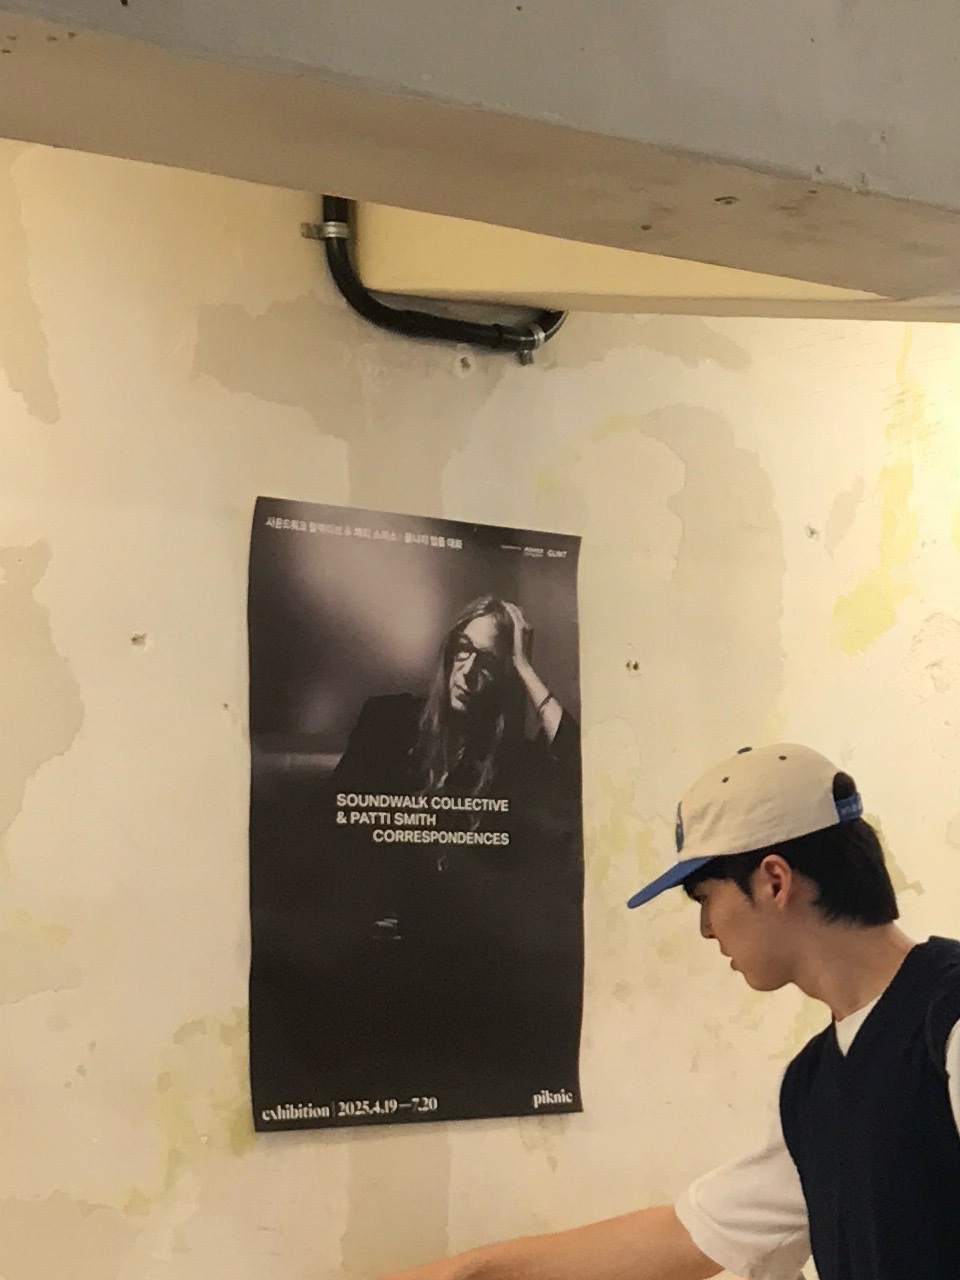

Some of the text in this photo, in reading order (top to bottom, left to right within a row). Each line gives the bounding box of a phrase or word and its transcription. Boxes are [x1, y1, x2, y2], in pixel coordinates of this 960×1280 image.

[336, 793, 509, 812] SOUNDWALK COLLECTIVE
[336, 811, 437, 826] & PATTI SMITH
[372, 829, 510, 845] CORRESPONDENCES
[533, 1088, 573, 1109] piknic
[261, 1102, 330, 1121] exhibition
